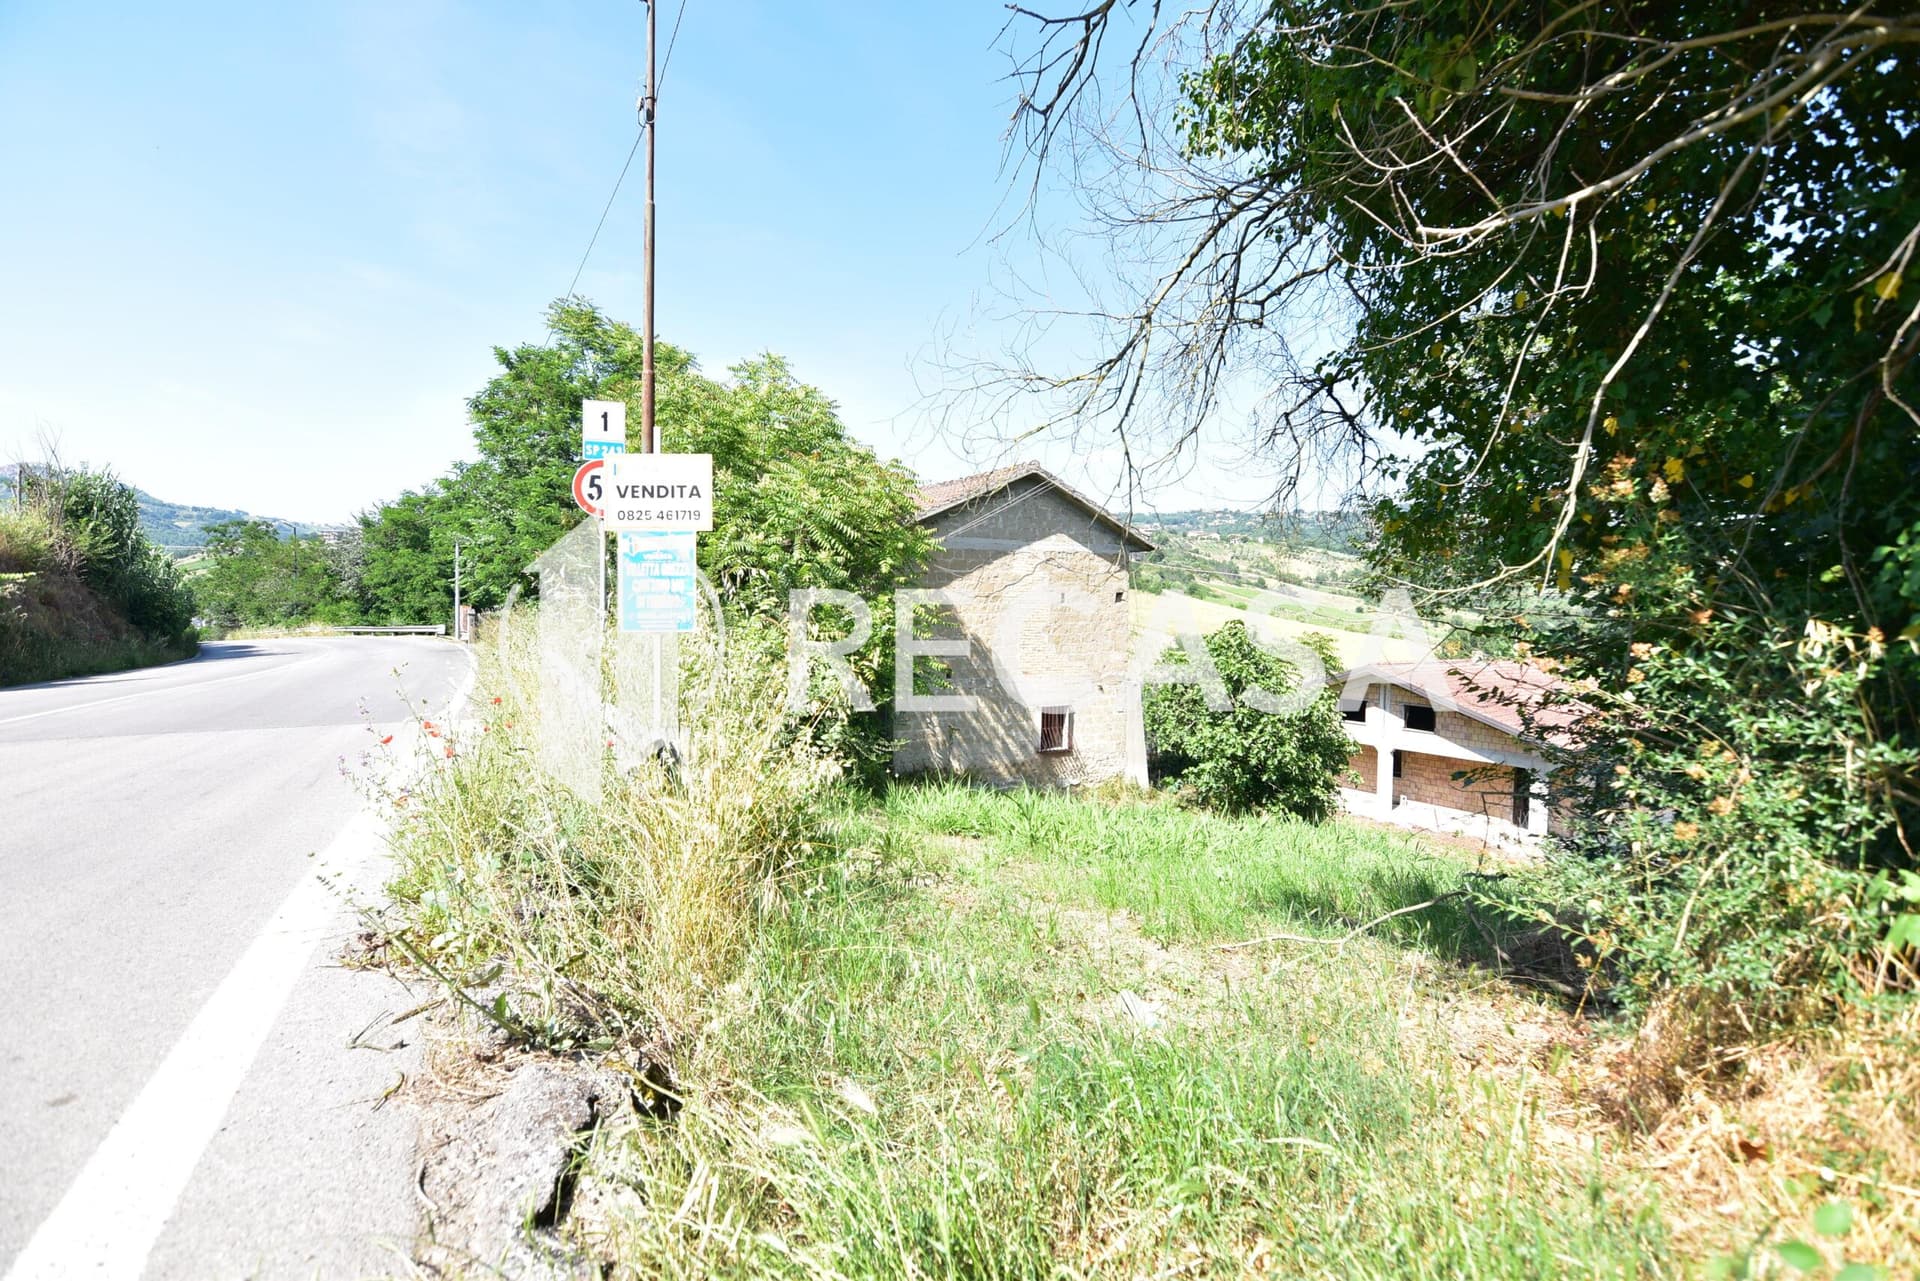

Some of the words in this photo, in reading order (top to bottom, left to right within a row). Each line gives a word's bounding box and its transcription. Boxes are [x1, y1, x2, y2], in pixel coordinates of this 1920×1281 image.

[601, 411, 608, 432] 1
[585, 444, 600, 456] SP
[616, 485, 702, 499] VENDITA
[617, 510, 652, 521] 0825
[656, 510, 701, 521] 461719
